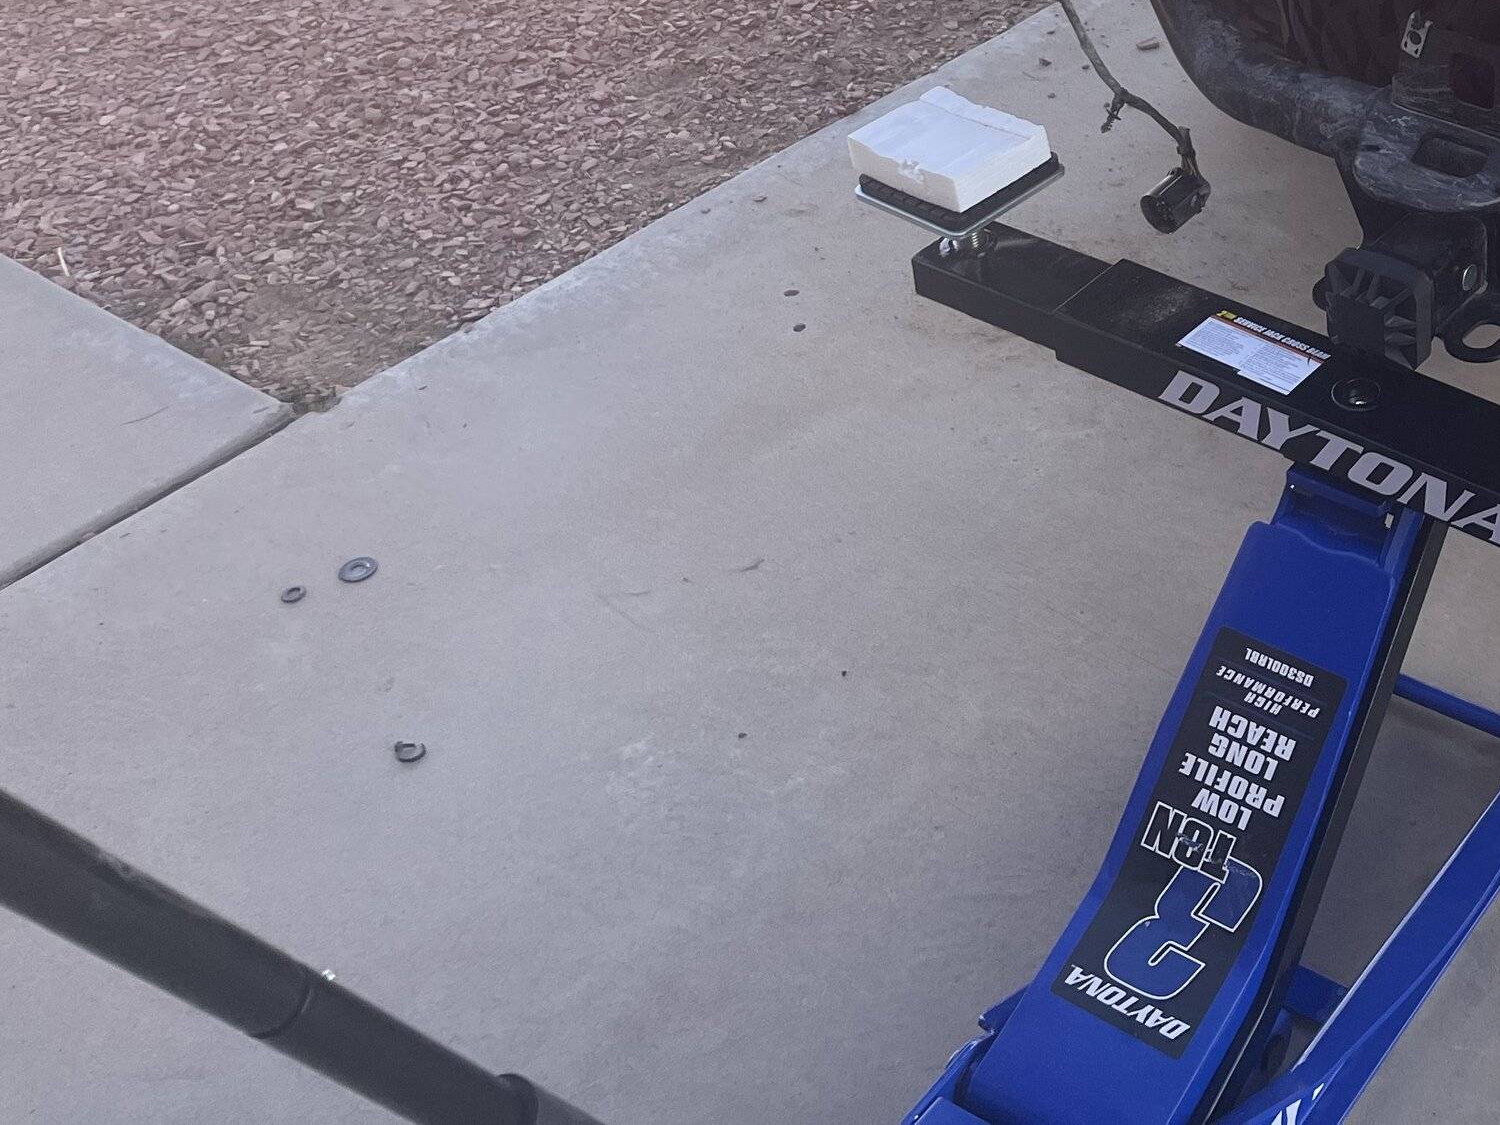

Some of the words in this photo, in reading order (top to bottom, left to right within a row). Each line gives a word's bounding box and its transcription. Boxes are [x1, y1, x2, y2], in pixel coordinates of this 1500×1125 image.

[1234, 317, 1267, 333] SERVICE
[1216, 665, 1321, 718] PERFORMANCE
[1244, 691, 1283, 715] HIGH
[1208, 705, 1297, 761] REACH
[1208, 732, 1279, 781] LONG
[1179, 752, 1285, 818] PROFILE
[1191, 787, 1252, 831] LOW
[1140, 801, 1237, 884] TON
[1104, 855, 1263, 1000] 3
[1065, 964, 1191, 1040] DAYTONA
